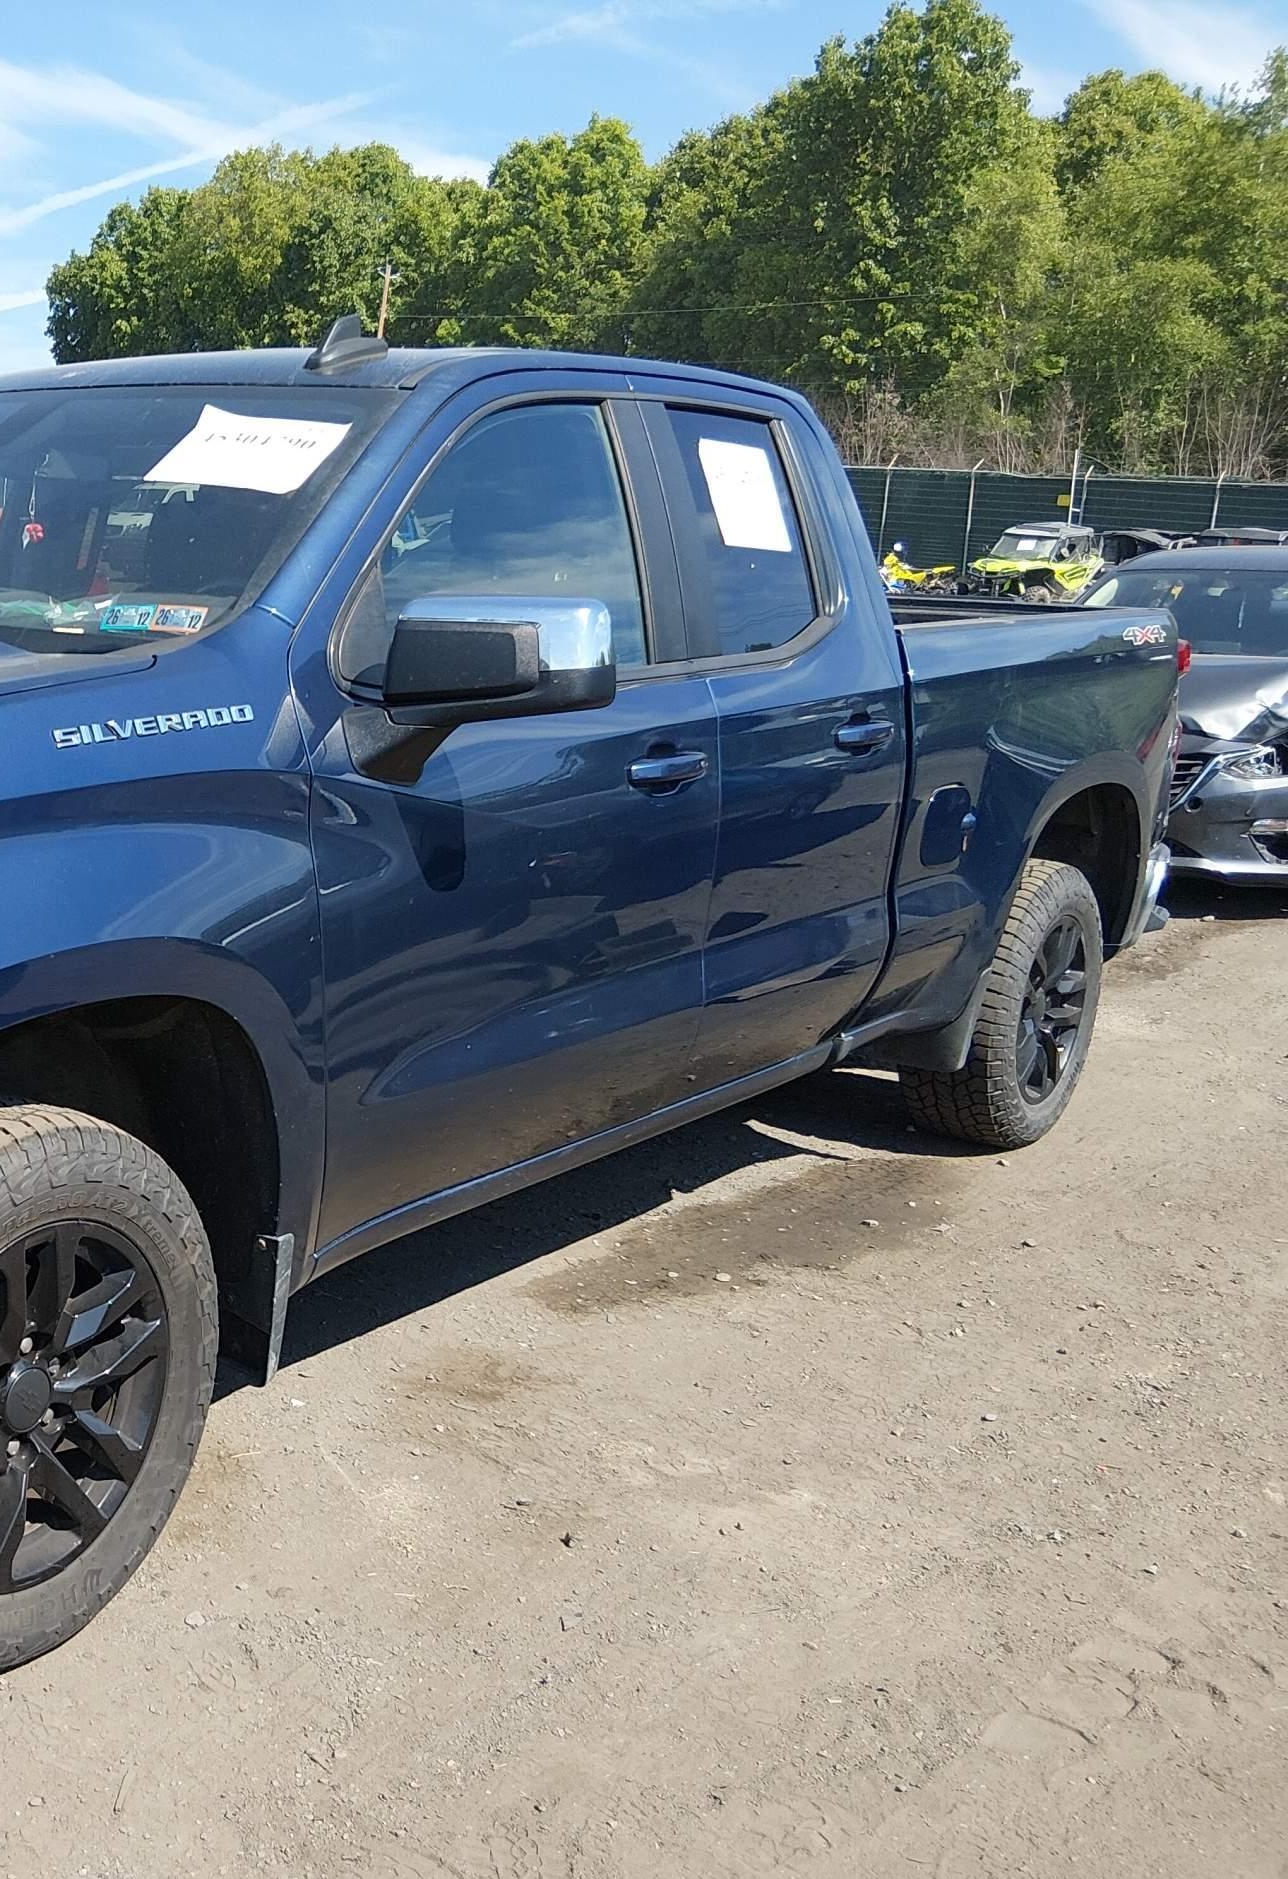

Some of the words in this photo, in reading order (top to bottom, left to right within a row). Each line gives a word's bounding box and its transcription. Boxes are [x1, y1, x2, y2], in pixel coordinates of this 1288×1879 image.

[106, 608, 121, 625] 26
[137, 611, 150, 626] 12
[155, 608, 171, 626] 26
[187, 614, 202, 630] 12
[53, 704, 255, 750] SILVERADO
